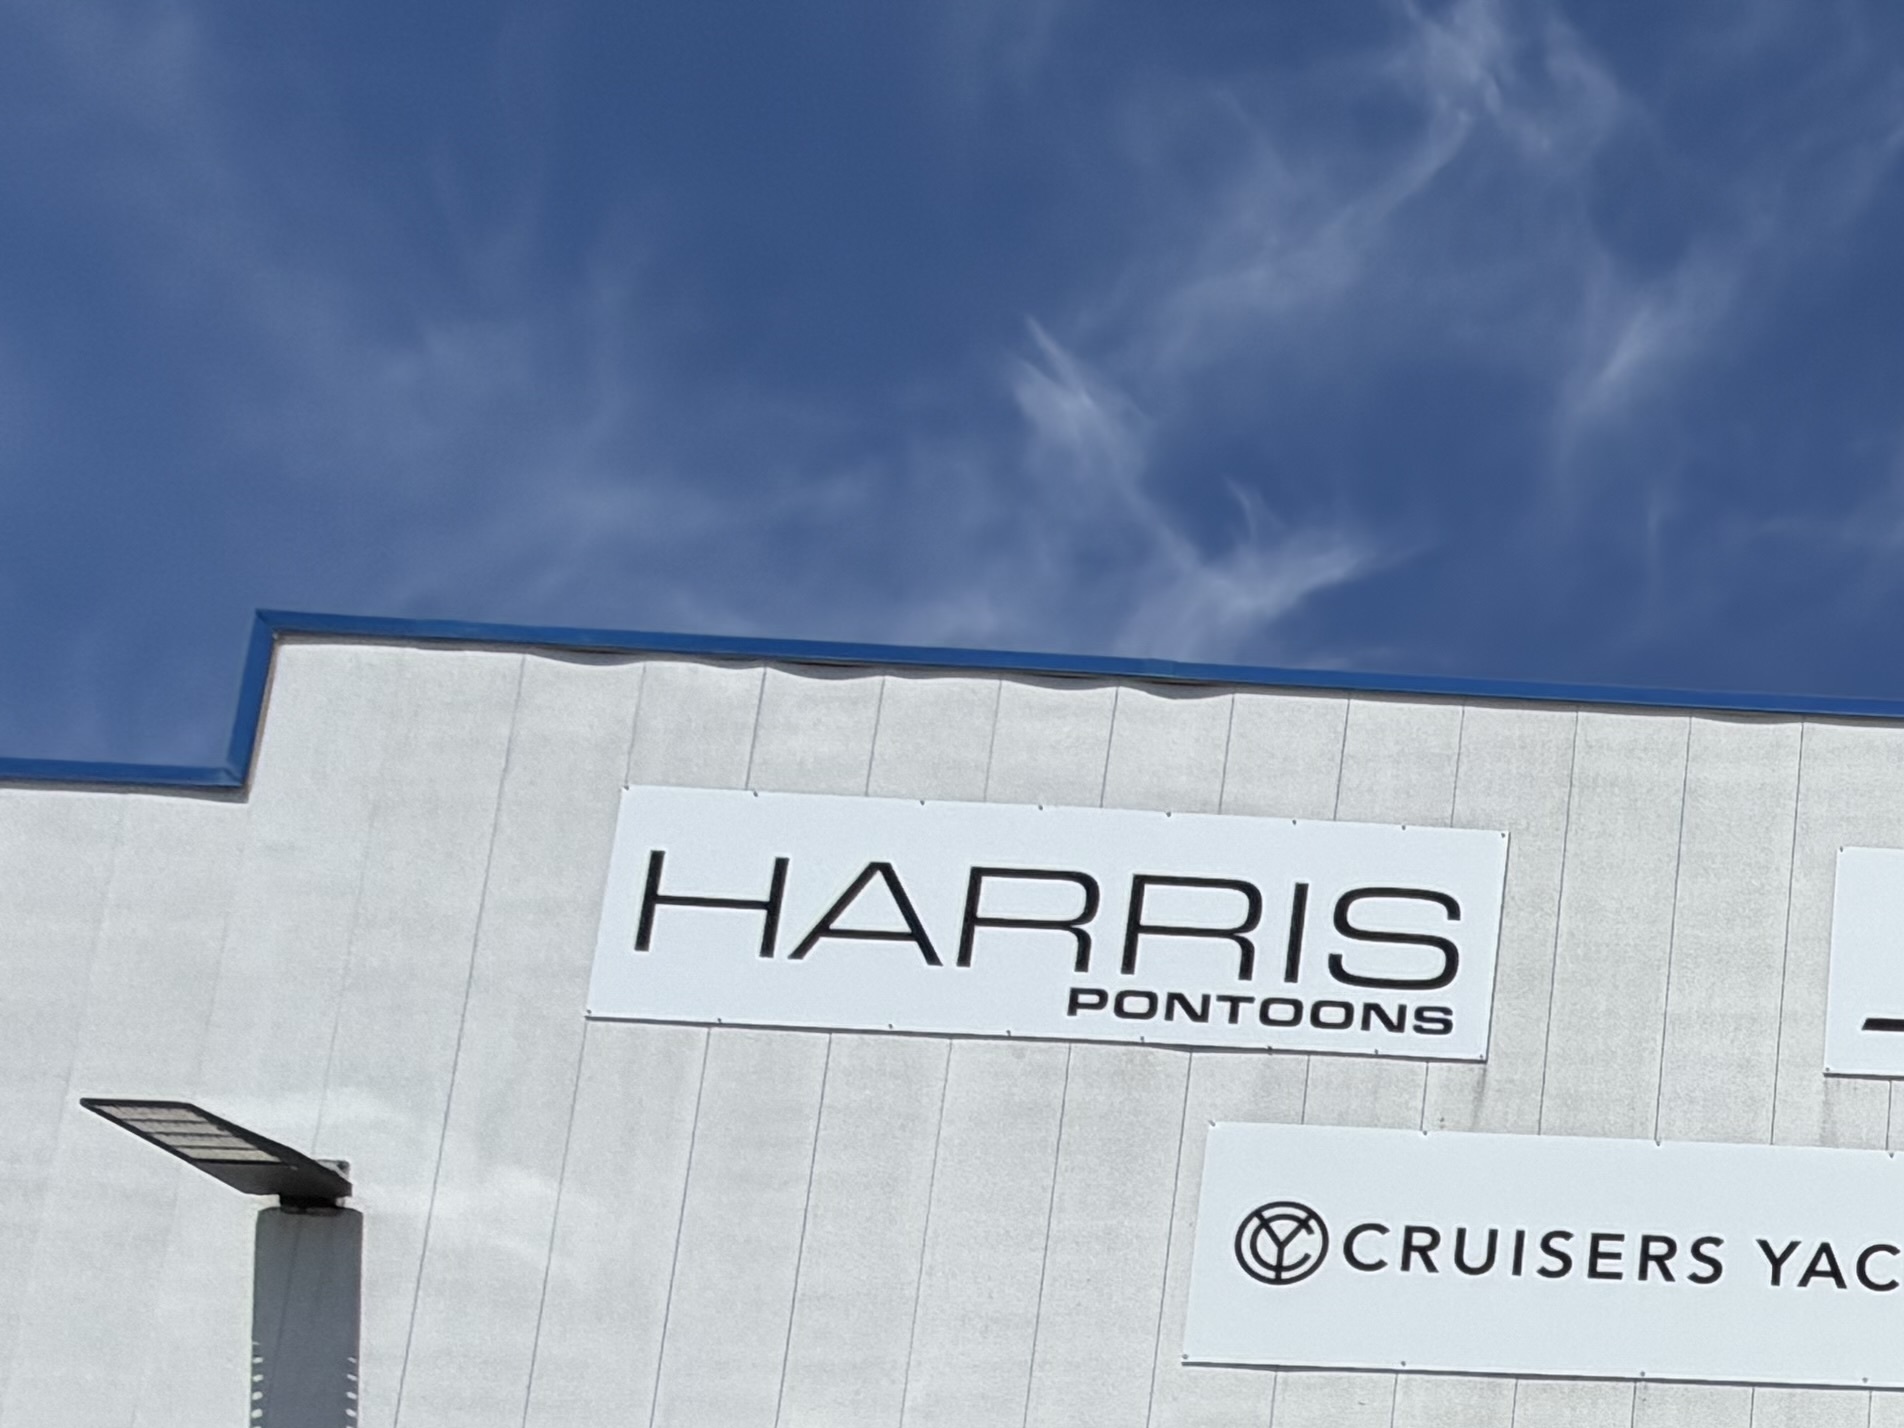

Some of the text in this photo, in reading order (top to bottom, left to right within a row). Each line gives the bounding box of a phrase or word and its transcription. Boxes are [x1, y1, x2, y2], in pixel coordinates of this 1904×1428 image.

[634, 850, 1461, 990] HARRIS
[1067, 987, 1453, 1035] PONTOONS
[1343, 1223, 1723, 1284] CRUISERS
